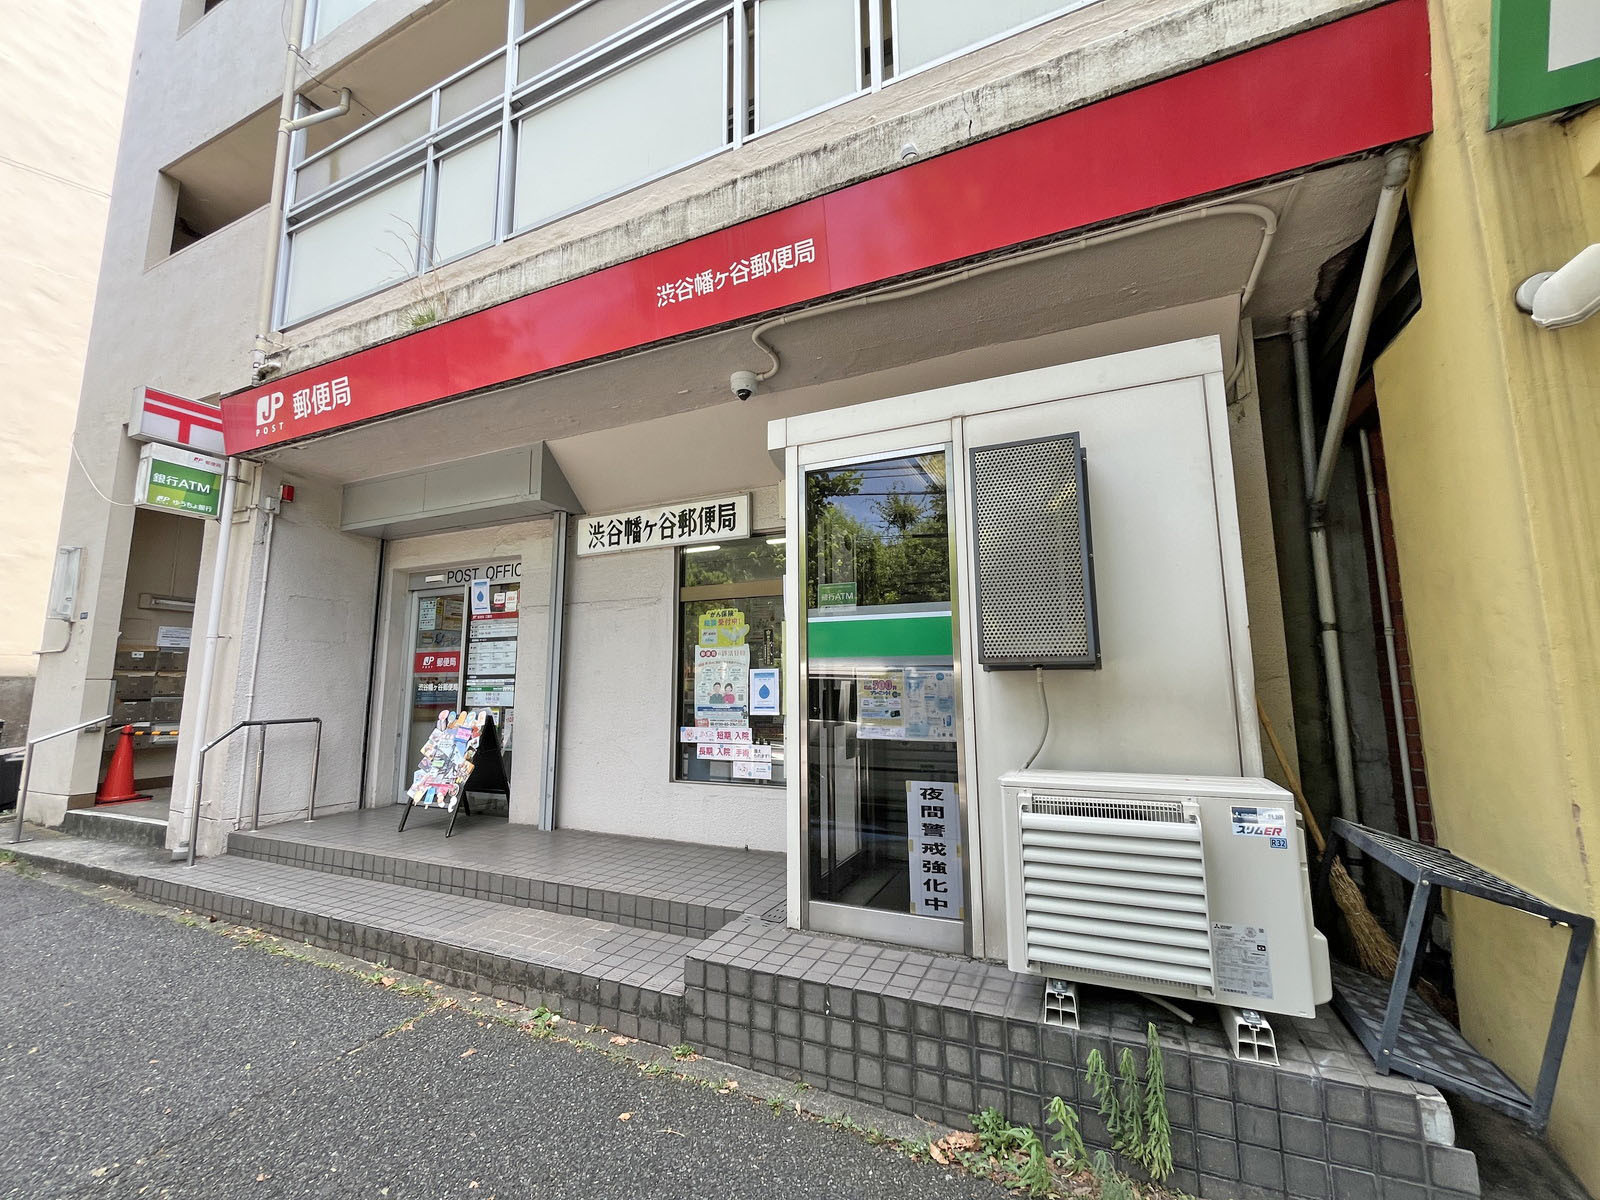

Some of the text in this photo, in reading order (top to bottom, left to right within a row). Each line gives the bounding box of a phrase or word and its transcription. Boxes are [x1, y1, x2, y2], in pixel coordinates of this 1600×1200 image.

[292, 376, 351, 420] 郵便局
[256, 422, 284, 437] POST
[152, 472, 211, 494] 銀行ATM
[447, 567, 480, 585] POST
[1236, 825, 1283, 836] スリムER
[919, 787, 949, 911] 夜間警戒強化中
[1271, 839, 1286, 848] R32
